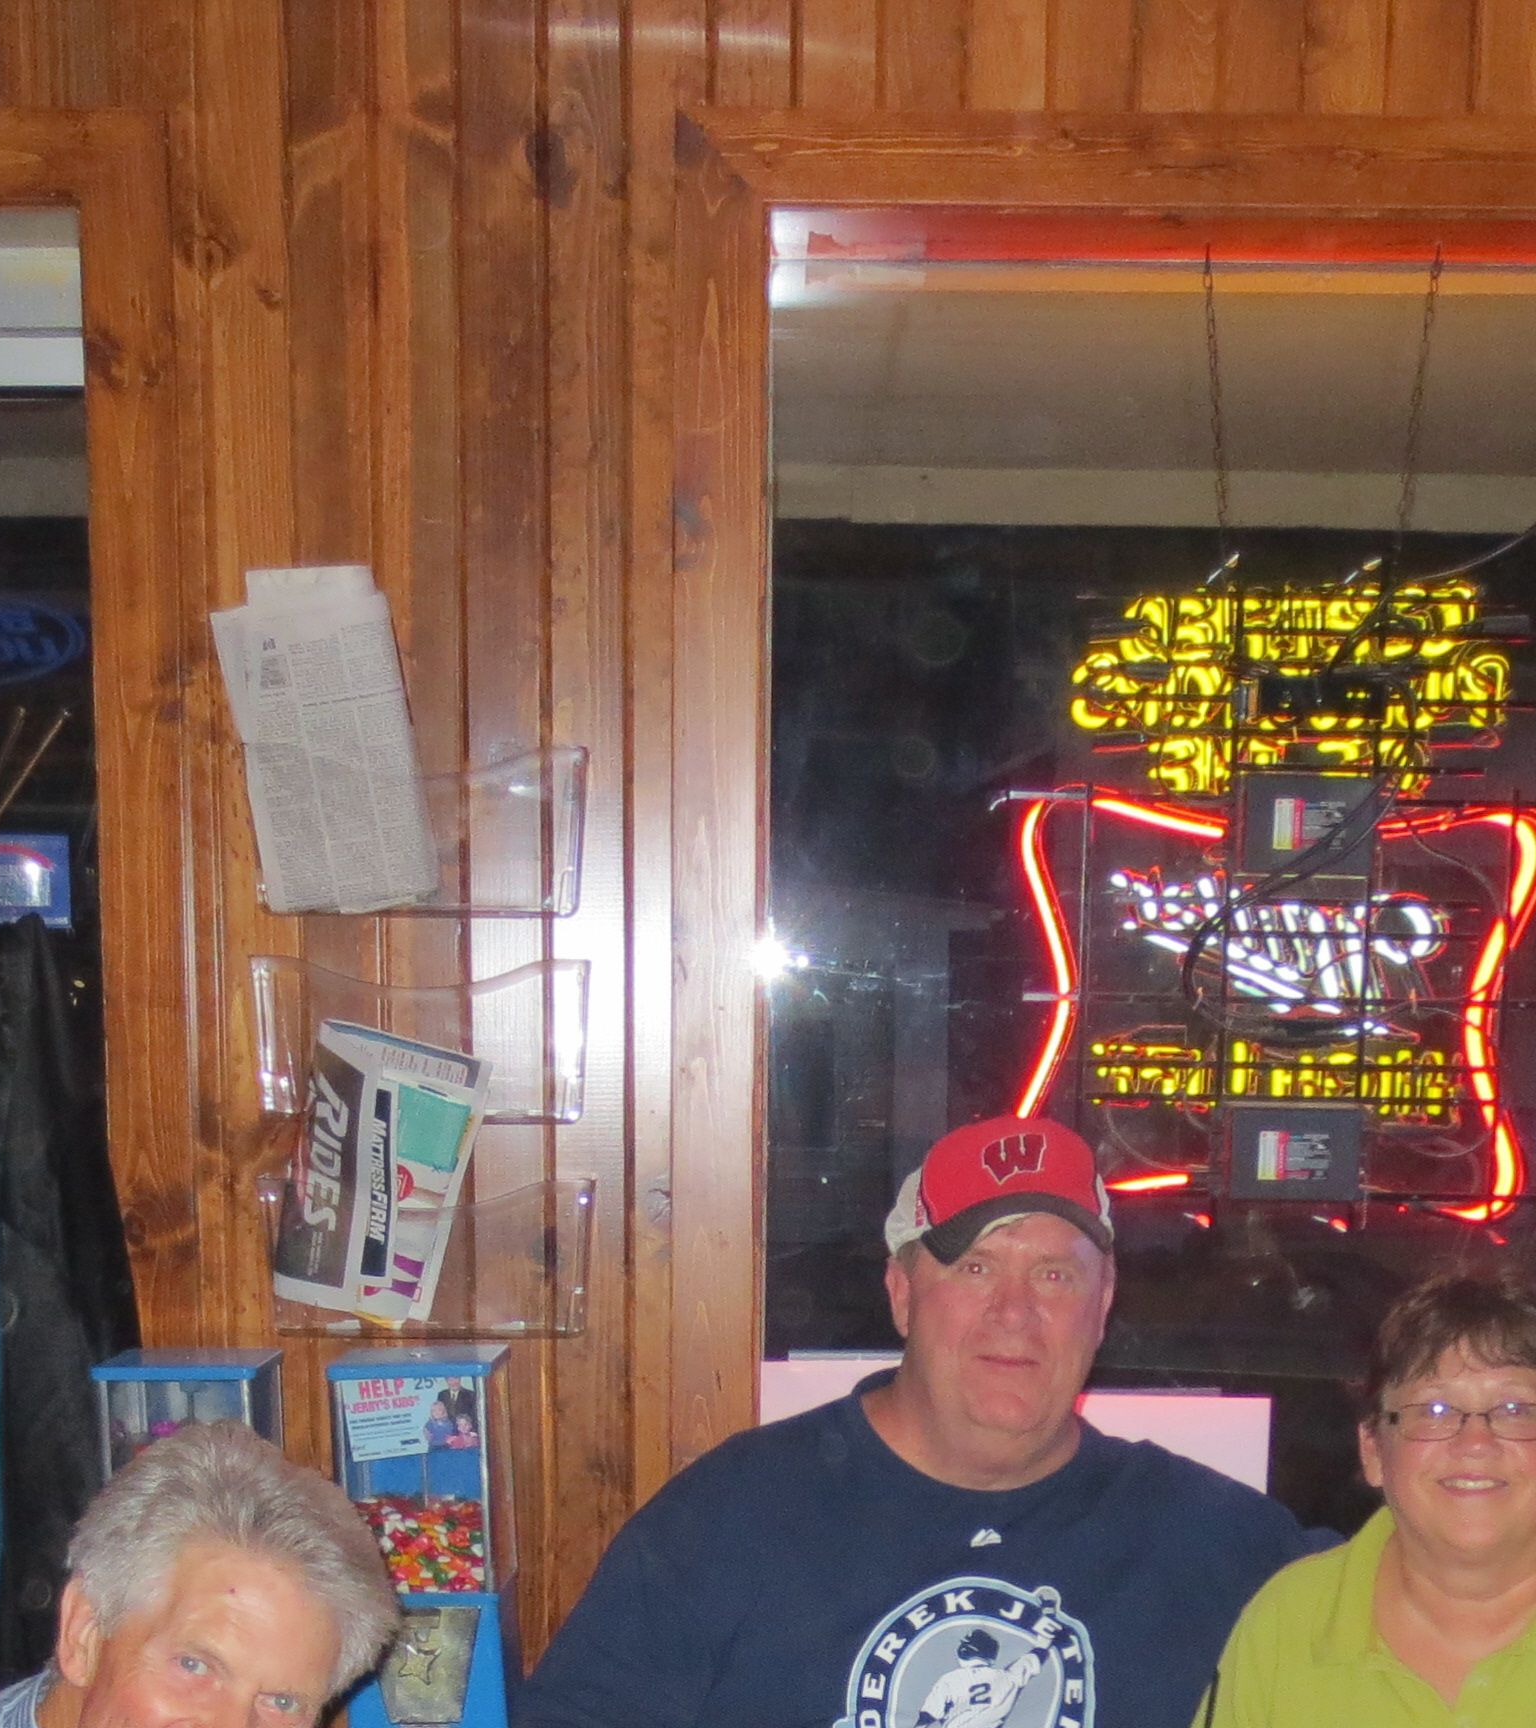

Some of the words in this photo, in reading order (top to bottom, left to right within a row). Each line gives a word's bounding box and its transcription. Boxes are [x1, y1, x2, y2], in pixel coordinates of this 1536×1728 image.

[304, 1073, 349, 1232] RIDES
[981, 1133, 1047, 1185] W
[357, 1377, 405, 1400] HELP
[968, 1682, 992, 1706] 2
